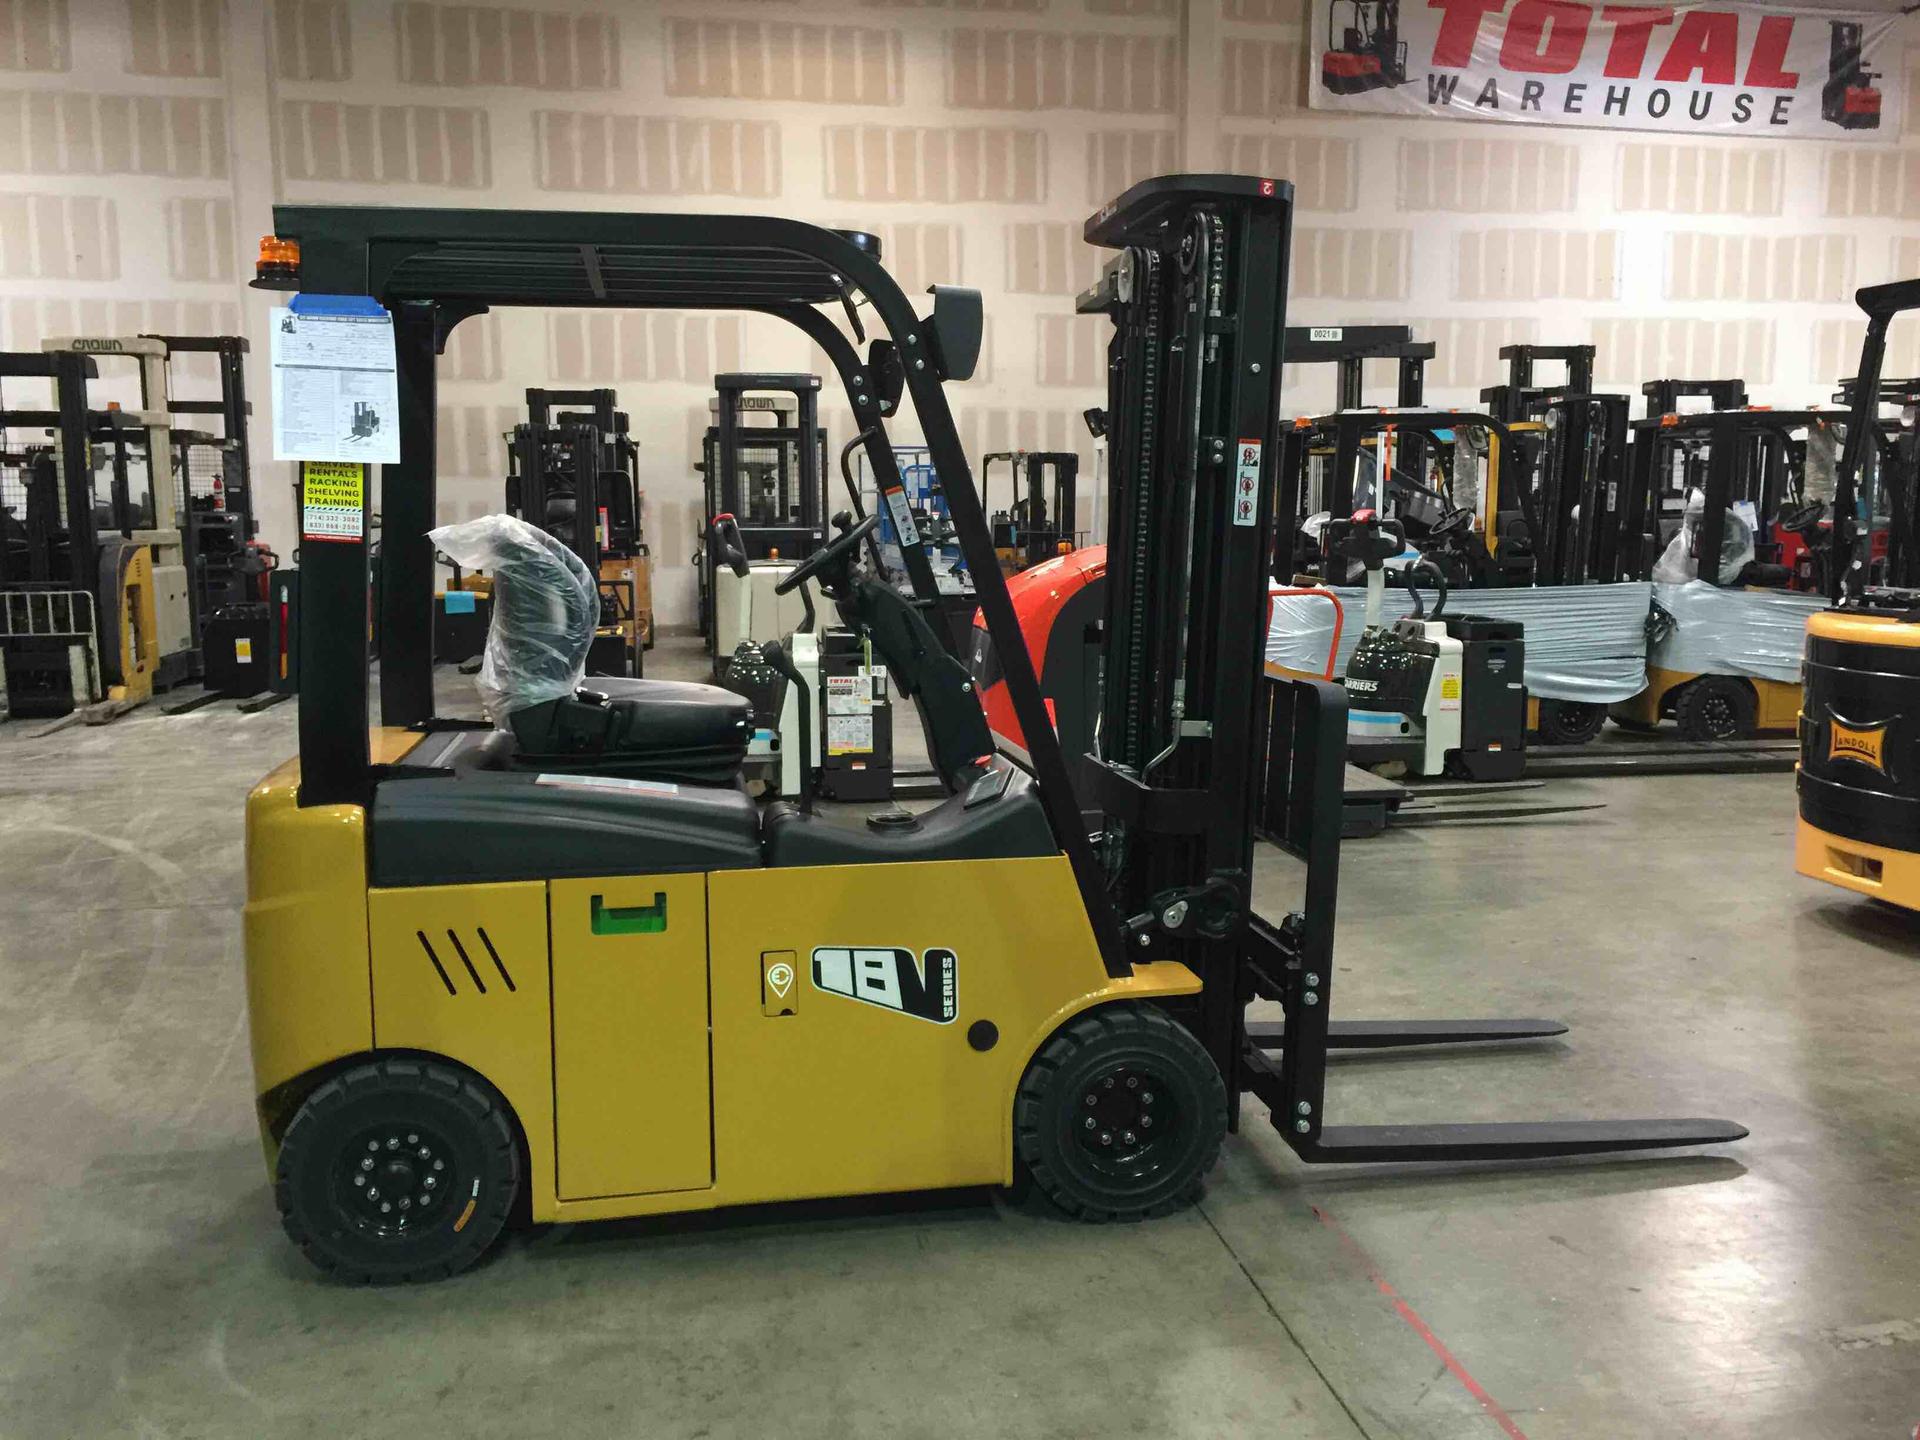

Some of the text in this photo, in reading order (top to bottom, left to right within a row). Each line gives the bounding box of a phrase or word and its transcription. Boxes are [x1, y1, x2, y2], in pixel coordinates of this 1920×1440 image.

[1427, 0, 1800, 89] TOTAL
[1427, 73, 1794, 125] WAREHOUSE
[1313, 329, 1331, 339] 0021
[71, 338, 123, 351] CROWN
[736, 397, 776, 410] ROWN
[309, 468, 358, 479] RENTALS
[309, 477, 358, 488] RACKING
[307, 487, 360, 498] SHELVING
[307, 497, 360, 507] TRAINING
[1834, 728, 1876, 760] LANDOLL
[943, 956, 953, 1018] SERIES
